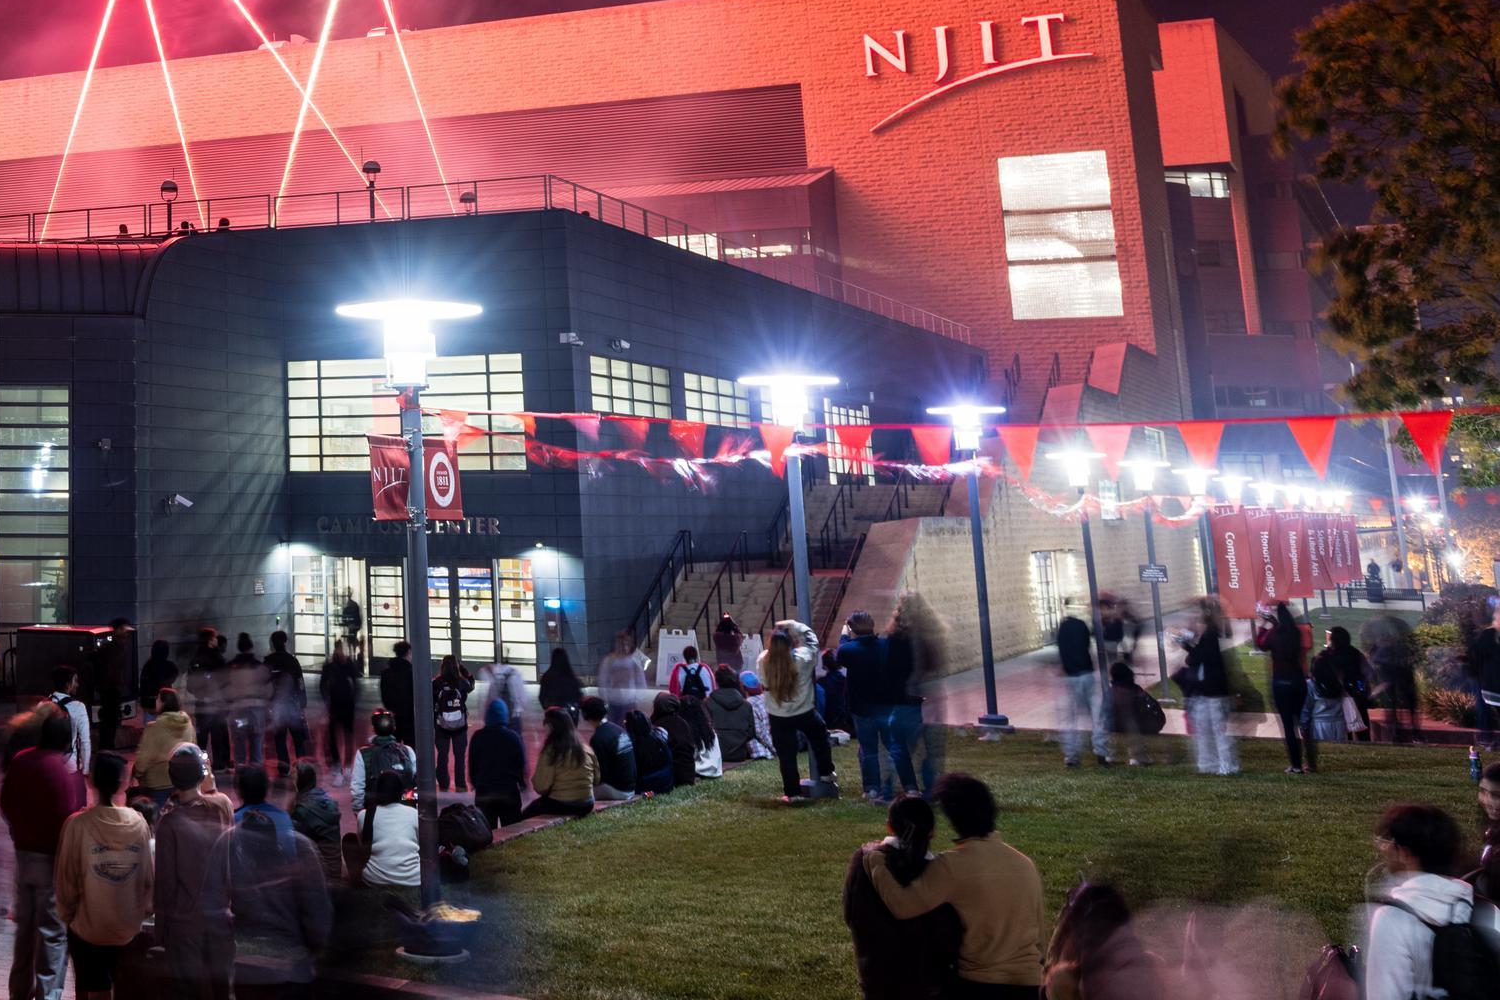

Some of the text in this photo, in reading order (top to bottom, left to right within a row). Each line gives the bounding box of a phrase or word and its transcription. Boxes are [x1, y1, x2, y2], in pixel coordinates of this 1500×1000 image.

[863, 12, 1065, 83] NJIT
[373, 466, 406, 486] NJIT
[1224, 531, 1240, 589] Computing
[1287, 530, 1301, 583] Management
[1308, 537, 1317, 562] Liberal
[1316, 529, 1326, 556] Science
[1259, 531, 1277, 598] Honors College
[1310, 562, 1319, 577] Arts
